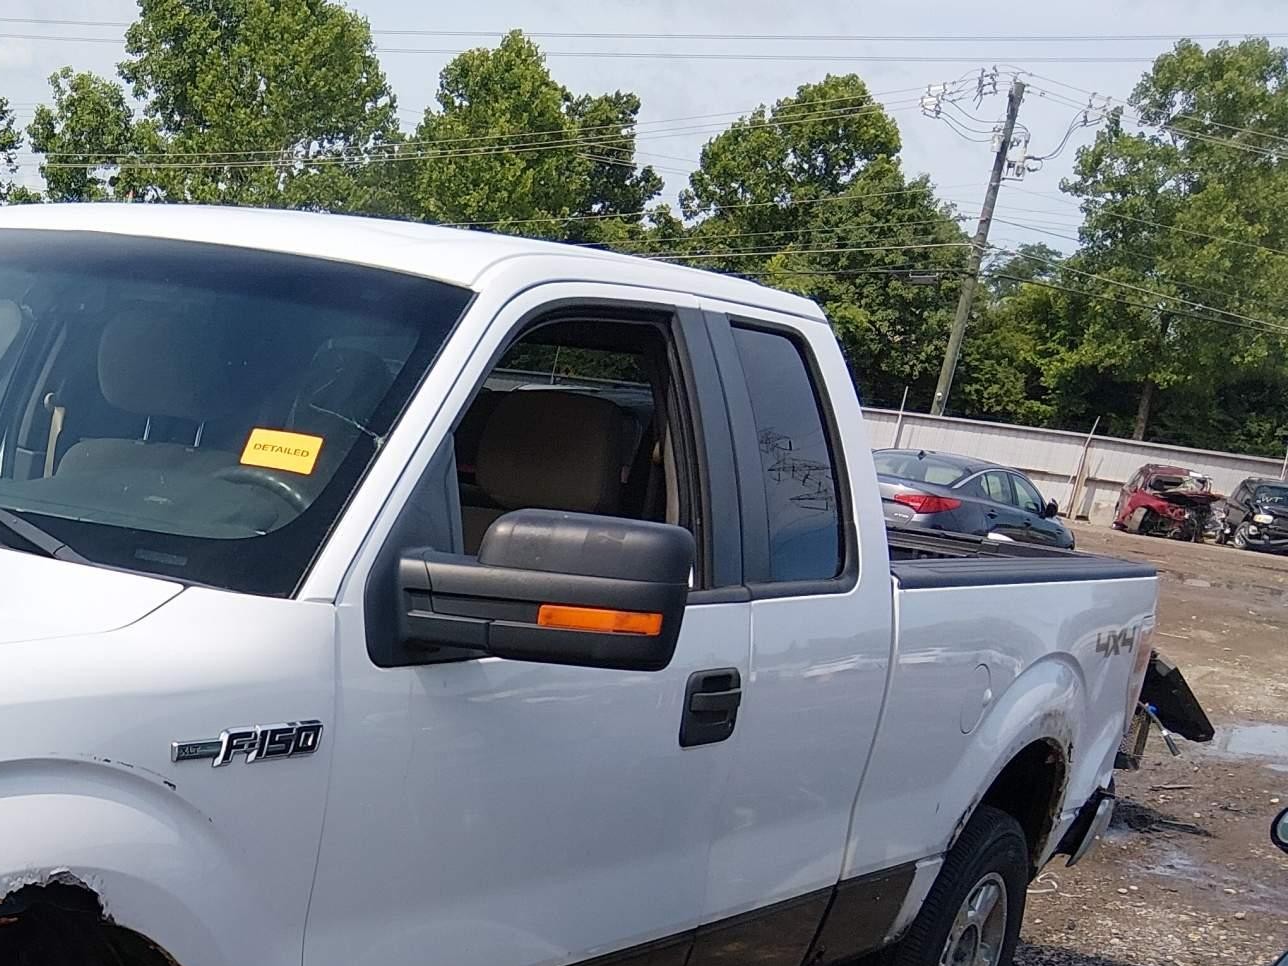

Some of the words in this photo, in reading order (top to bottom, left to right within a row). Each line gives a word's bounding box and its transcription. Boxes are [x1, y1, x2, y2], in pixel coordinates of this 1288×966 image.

[253, 443, 310, 457] DETAILED
[180, 746, 201, 756] XLT
[212, 720, 324, 767] F-150
